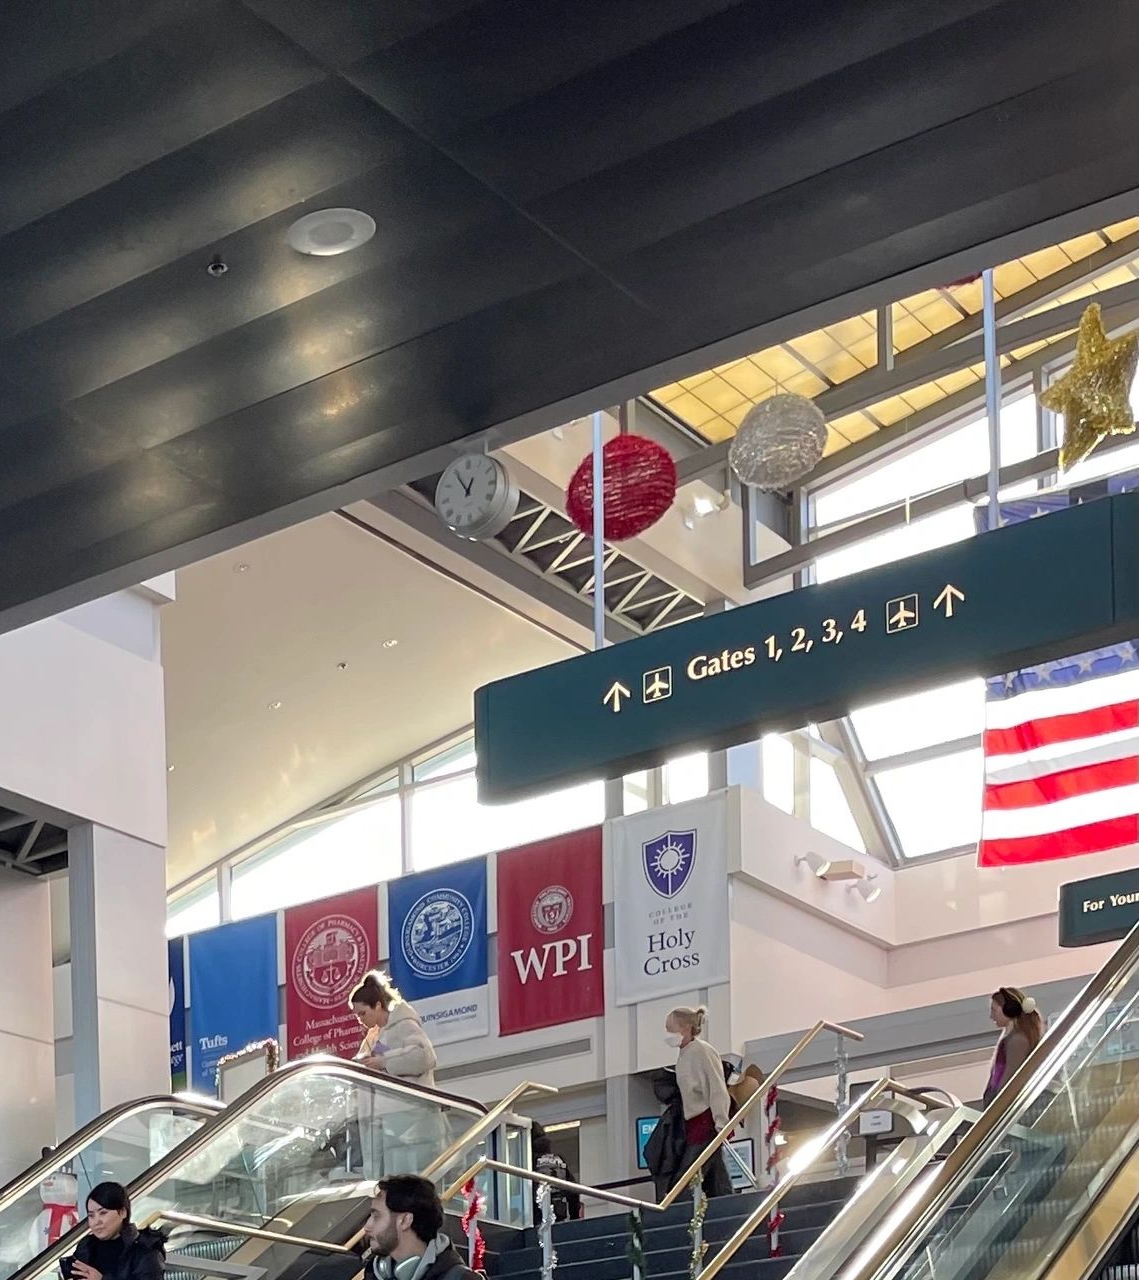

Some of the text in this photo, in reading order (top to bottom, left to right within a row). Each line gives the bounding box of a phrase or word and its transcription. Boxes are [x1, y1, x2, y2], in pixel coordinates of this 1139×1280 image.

[686, 609, 867, 681] Gates 1, 2, 3, 4
[648, 902, 693, 919] COLLEGE
[1082, 899, 1105, 913] For
[647, 927, 696, 954] Holy
[510, 932, 593, 985] WPI
[643, 952, 700, 976] Cross
[199, 1034, 229, 1051] Tufts
